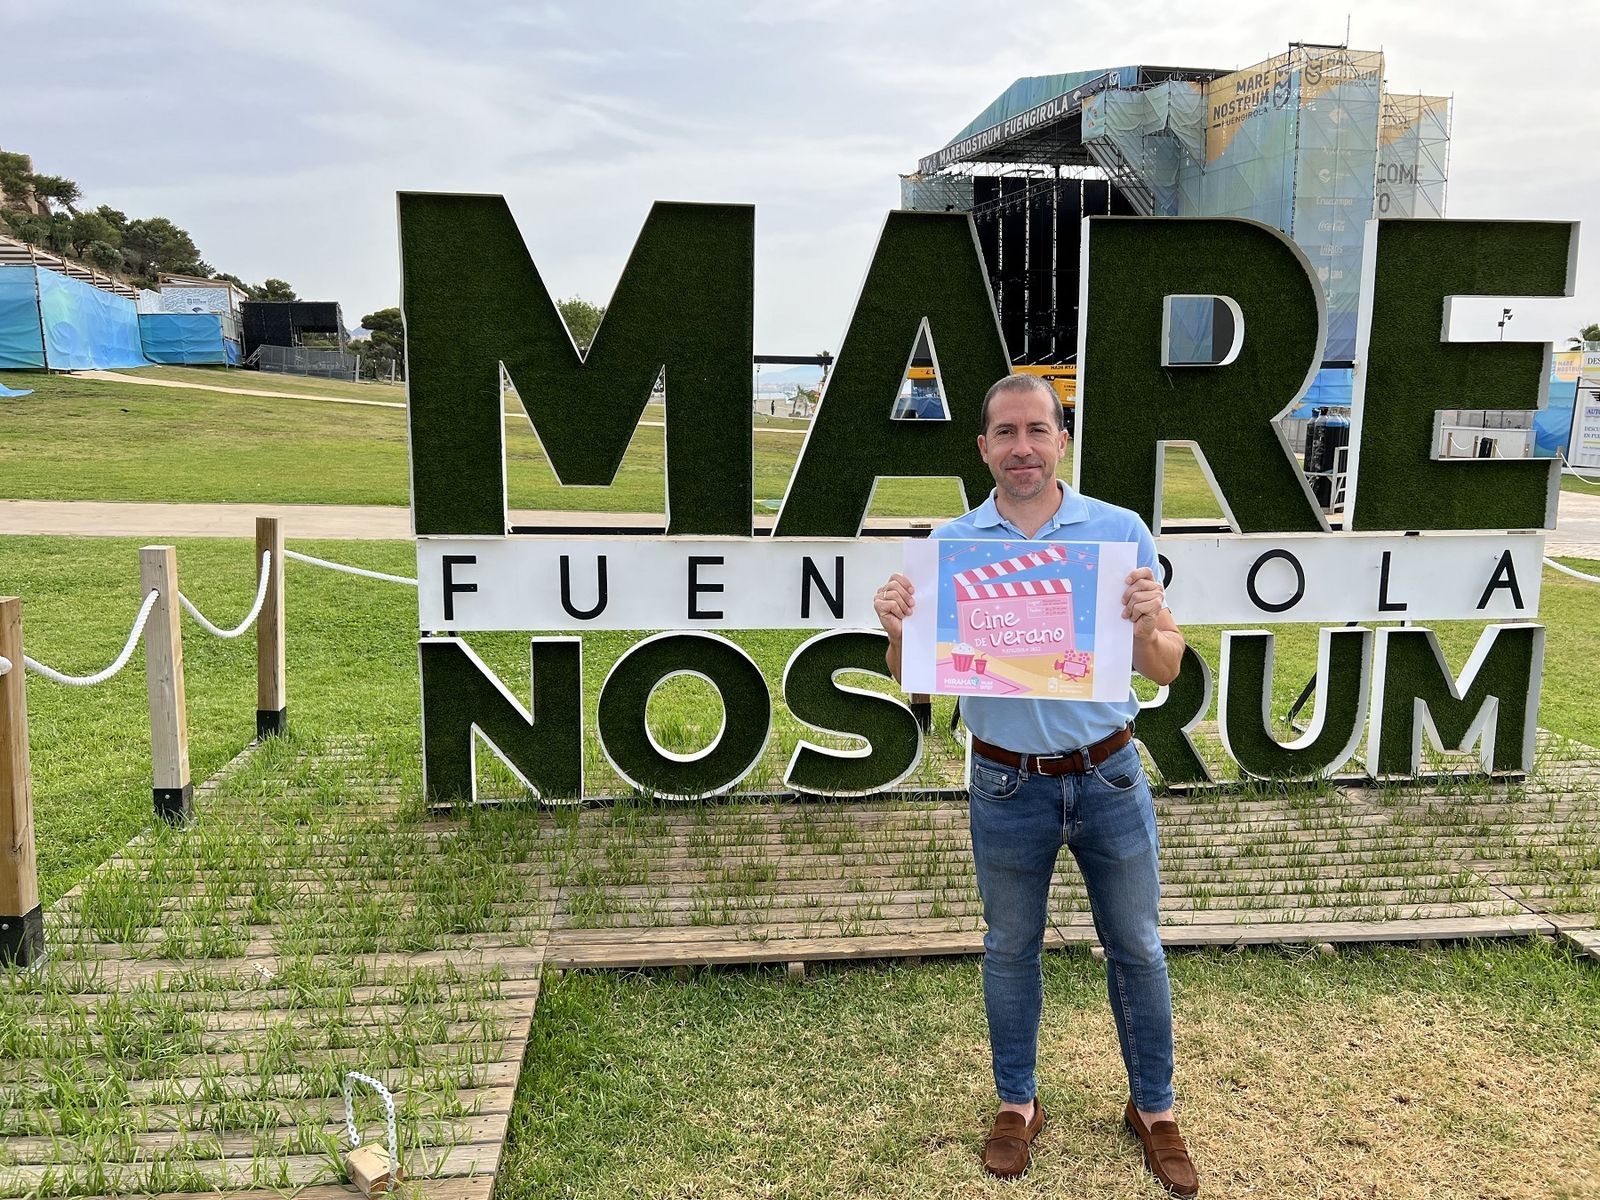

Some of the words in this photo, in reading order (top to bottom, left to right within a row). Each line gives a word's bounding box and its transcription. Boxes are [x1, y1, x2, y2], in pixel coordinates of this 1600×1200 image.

[1236, 71, 1270, 94] MARE
[1213, 89, 1269, 121] NOSTRUM
[1221, 107, 1269, 127] FUENGIROLA
[939, 126, 1001, 164] MARENOSTRUM
[1004, 95, 1069, 138] FUENGIROLA
[396, 190, 1580, 538] MARE
[442, 549, 1525, 622] FUENOLA
[970, 608, 1021, 630] Cine
[975, 638, 987, 648] DE
[989, 627, 1065, 648] verano
[414, 629, 1545, 808] NOSRUM
